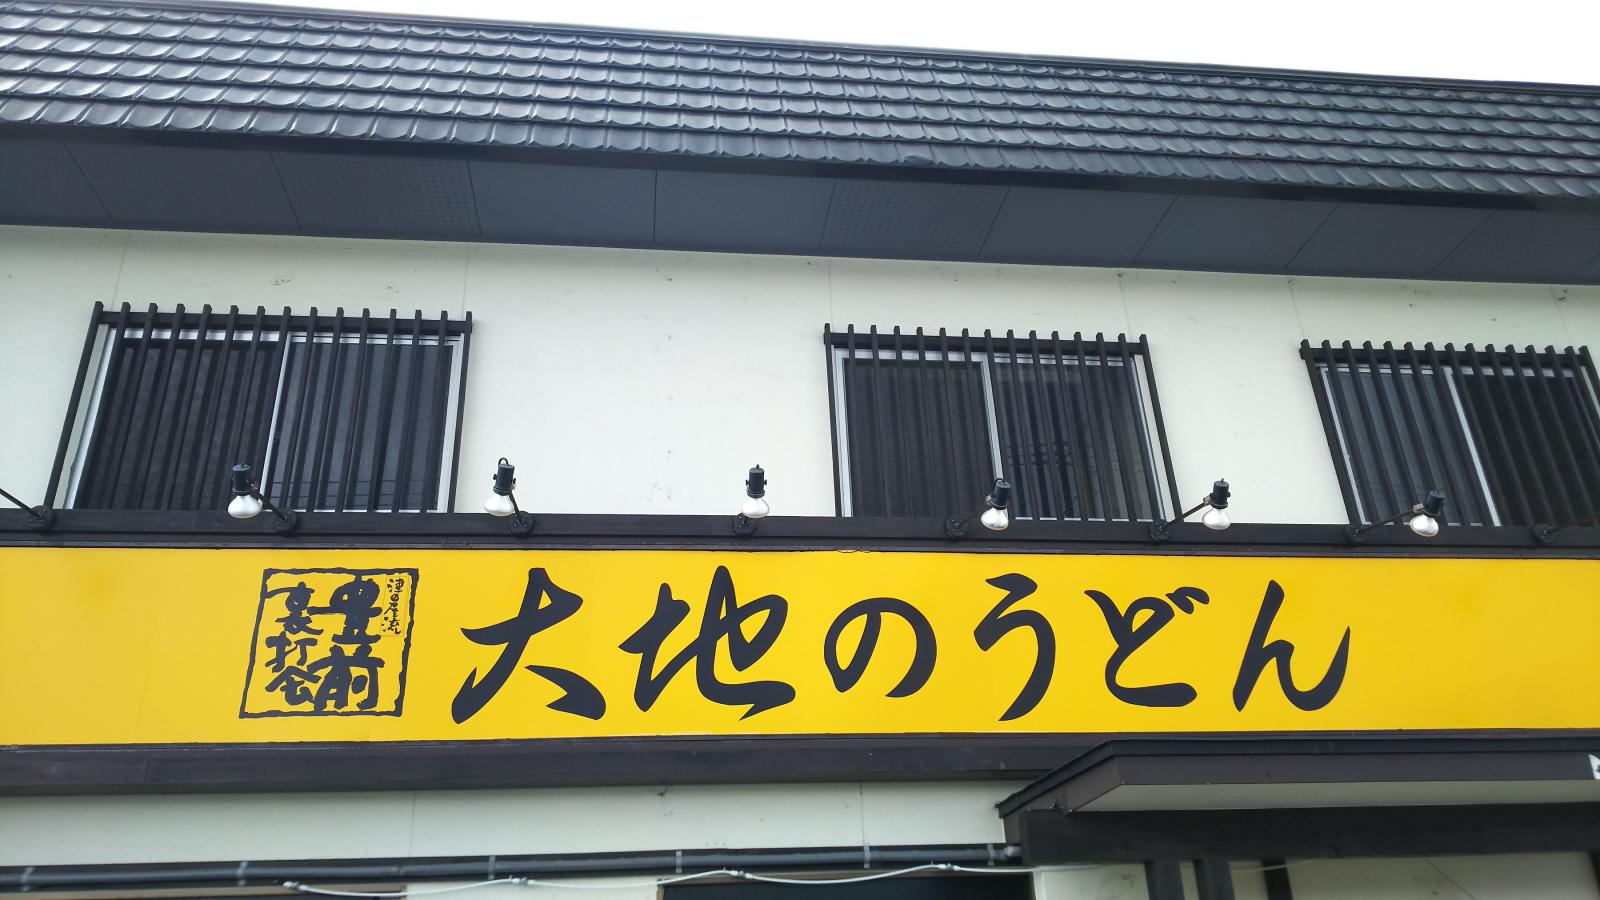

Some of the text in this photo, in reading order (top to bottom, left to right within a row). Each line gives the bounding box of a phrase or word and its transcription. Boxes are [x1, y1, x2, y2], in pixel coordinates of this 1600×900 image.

[306, 573, 385, 713] 豊前
[452, 566, 1350, 724] 大地のうどん
